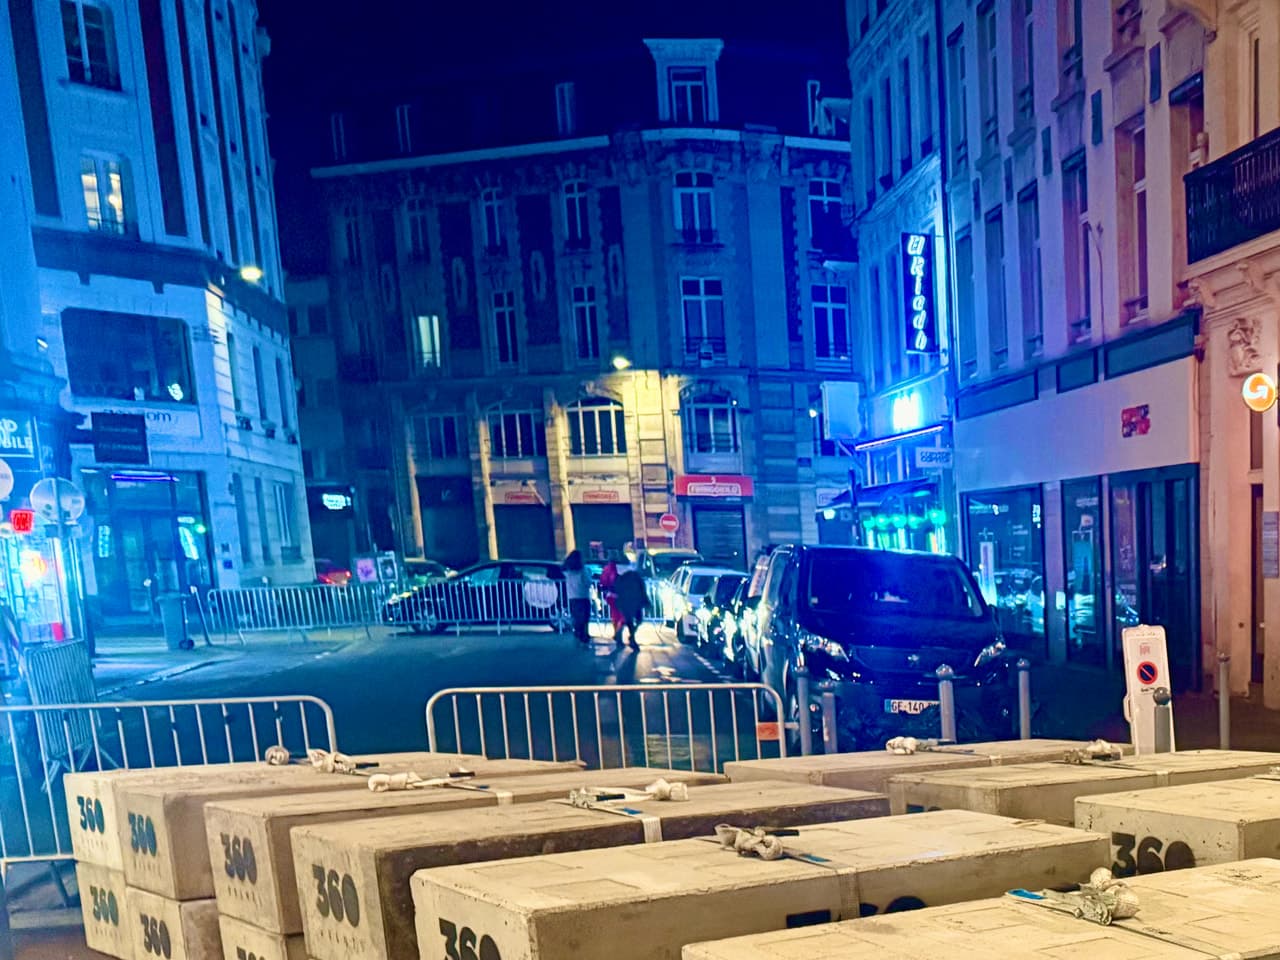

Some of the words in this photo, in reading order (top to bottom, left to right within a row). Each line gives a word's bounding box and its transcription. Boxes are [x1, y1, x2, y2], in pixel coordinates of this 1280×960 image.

[77, 795, 105, 834] 360
[128, 811, 157, 858] 360
[220, 831, 257, 884] 360
[89, 885, 119, 927] 360
[312, 863, 360, 928] 360
[140, 912, 172, 960] 360
